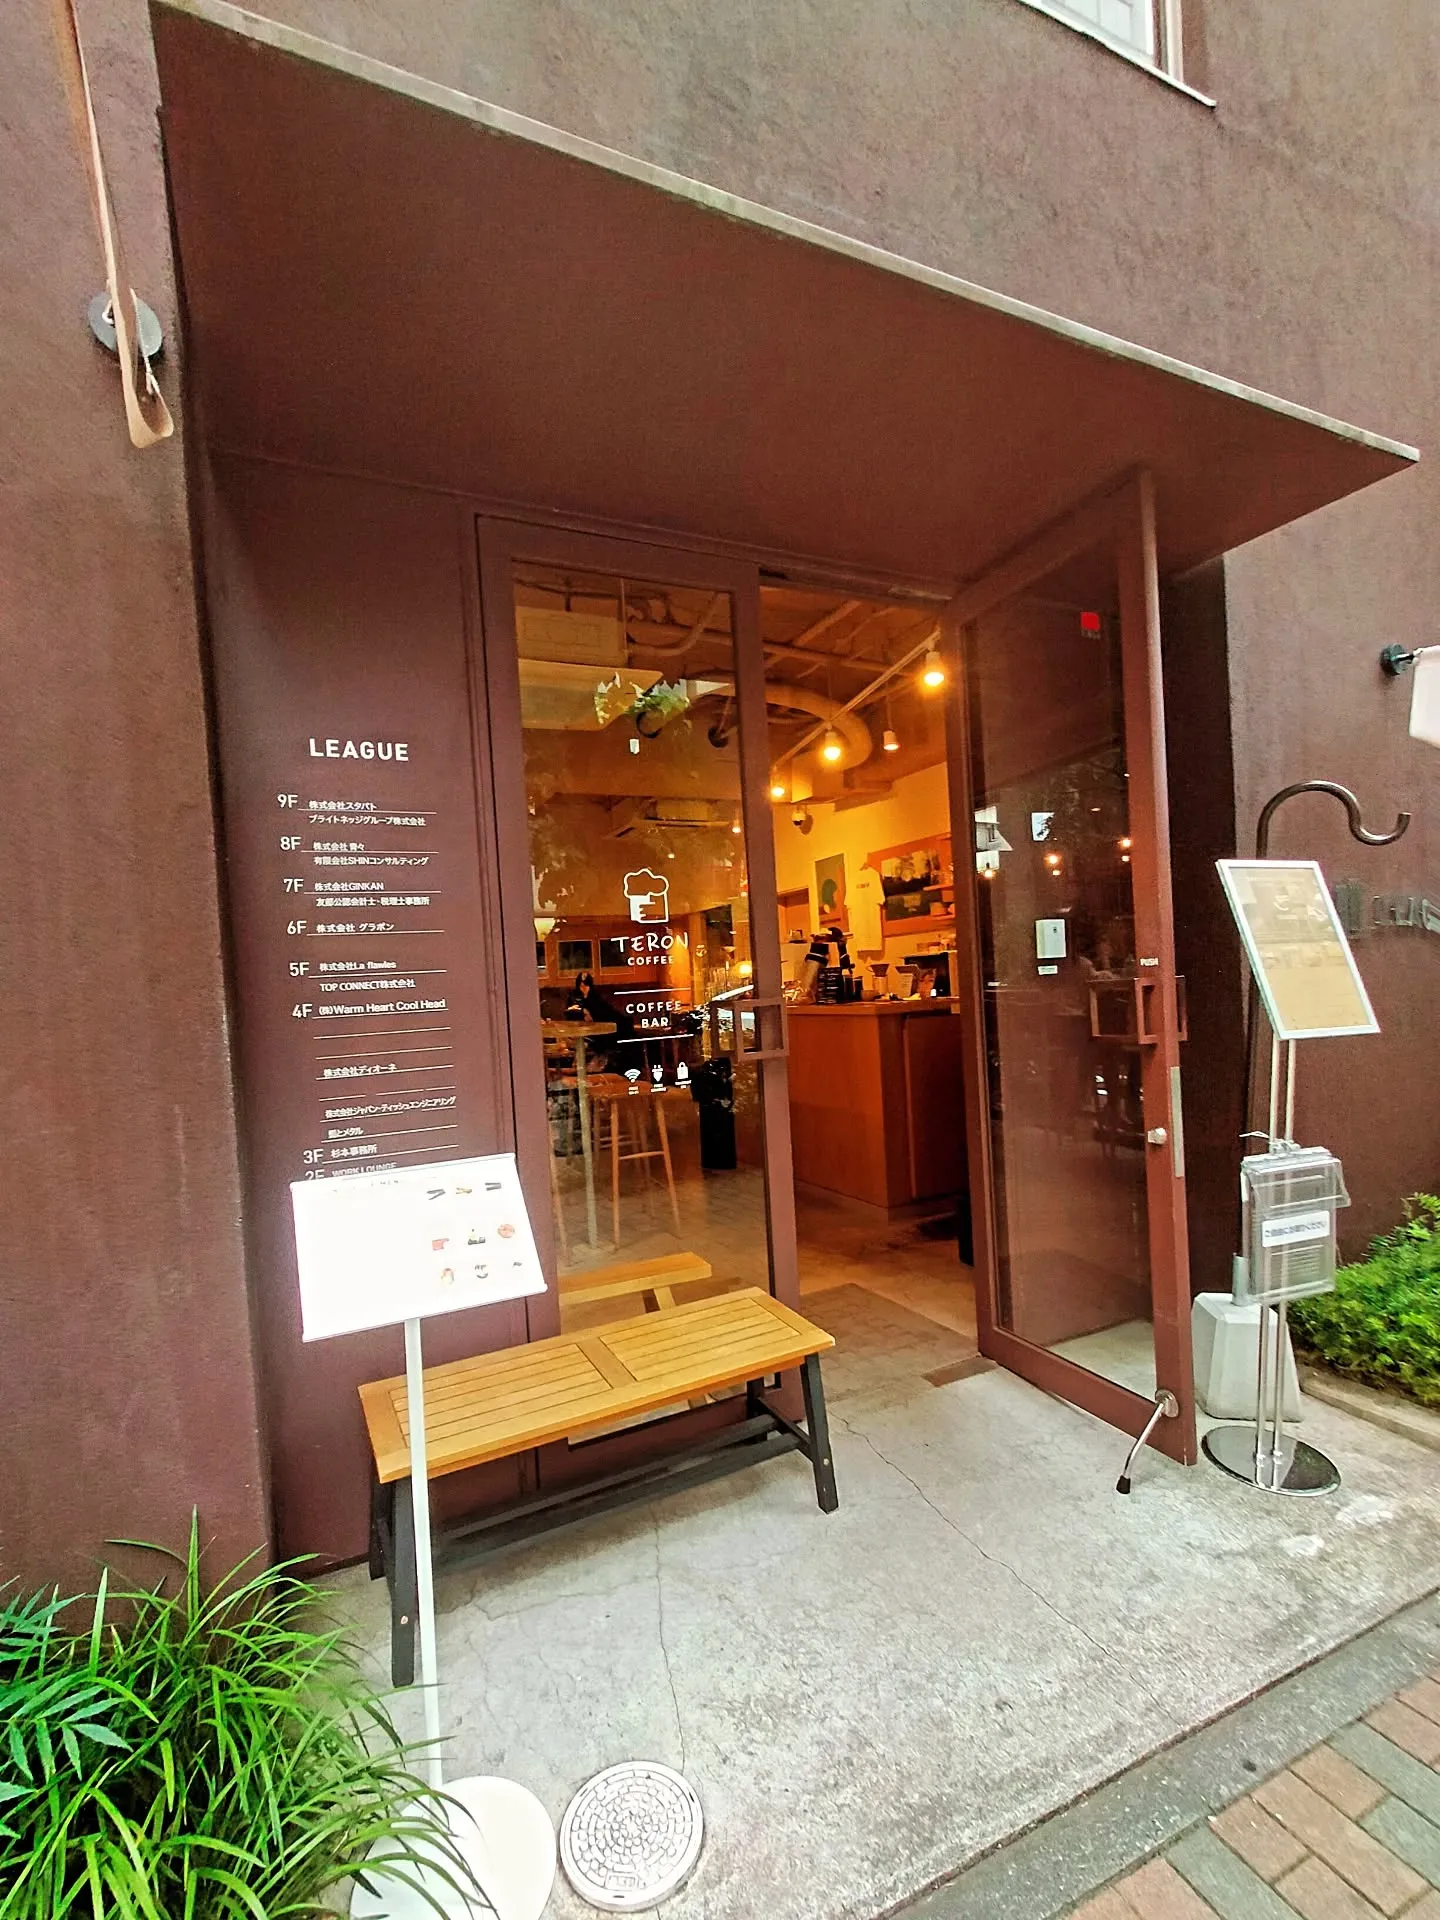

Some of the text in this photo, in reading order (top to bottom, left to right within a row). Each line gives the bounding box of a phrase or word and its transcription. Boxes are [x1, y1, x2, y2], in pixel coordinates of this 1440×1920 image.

[308, 738, 410, 763] LEAGUE
[277, 793, 298, 809] 9F
[280, 836, 302, 851] 8F
[313, 841, 348, 851] 株式会社
[314, 856, 430, 867] 有限会社SHINコンサルティング
[283, 878, 386, 893] 7F 株式会社GINKAN
[287, 920, 307, 935] 6F
[316, 923, 356, 934] 株式会社
[627, 956, 675, 966] COFFEE
[1140, 957, 1159, 967] PUSH
[289, 961, 310, 977] 5F
[320, 978, 417, 992] TOP CONNECT株式会社
[292, 1003, 313, 1018] 4F
[365, 1002, 395, 1014] Heart
[396, 1000, 420, 1011] Cool
[421, 998, 447, 1009] Head
[626, 1000, 682, 1014] COFFEE
[641, 1017, 669, 1028] BAR
[303, 1143, 378, 1164] 3F 杉本事務所
